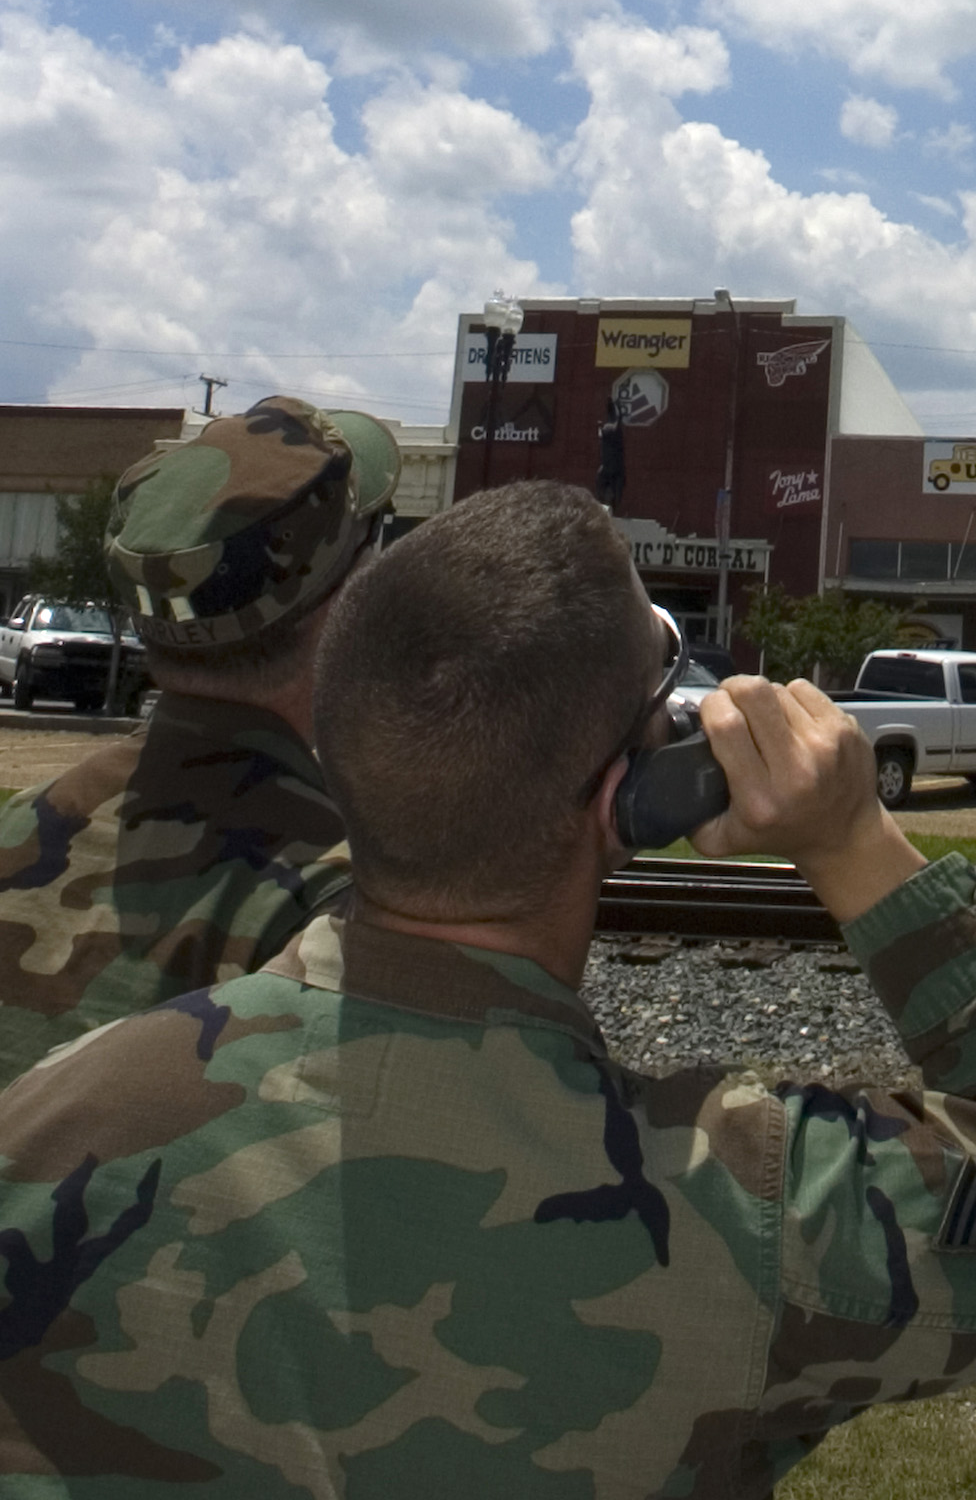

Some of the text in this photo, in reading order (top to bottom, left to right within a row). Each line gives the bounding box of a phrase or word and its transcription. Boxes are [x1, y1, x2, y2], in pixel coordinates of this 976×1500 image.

[601, 329, 687, 358] Wrangler
[768, 468, 806, 496] Tony
[776, 485, 822, 509] Lama
[684, 545, 757, 570] CORAL
